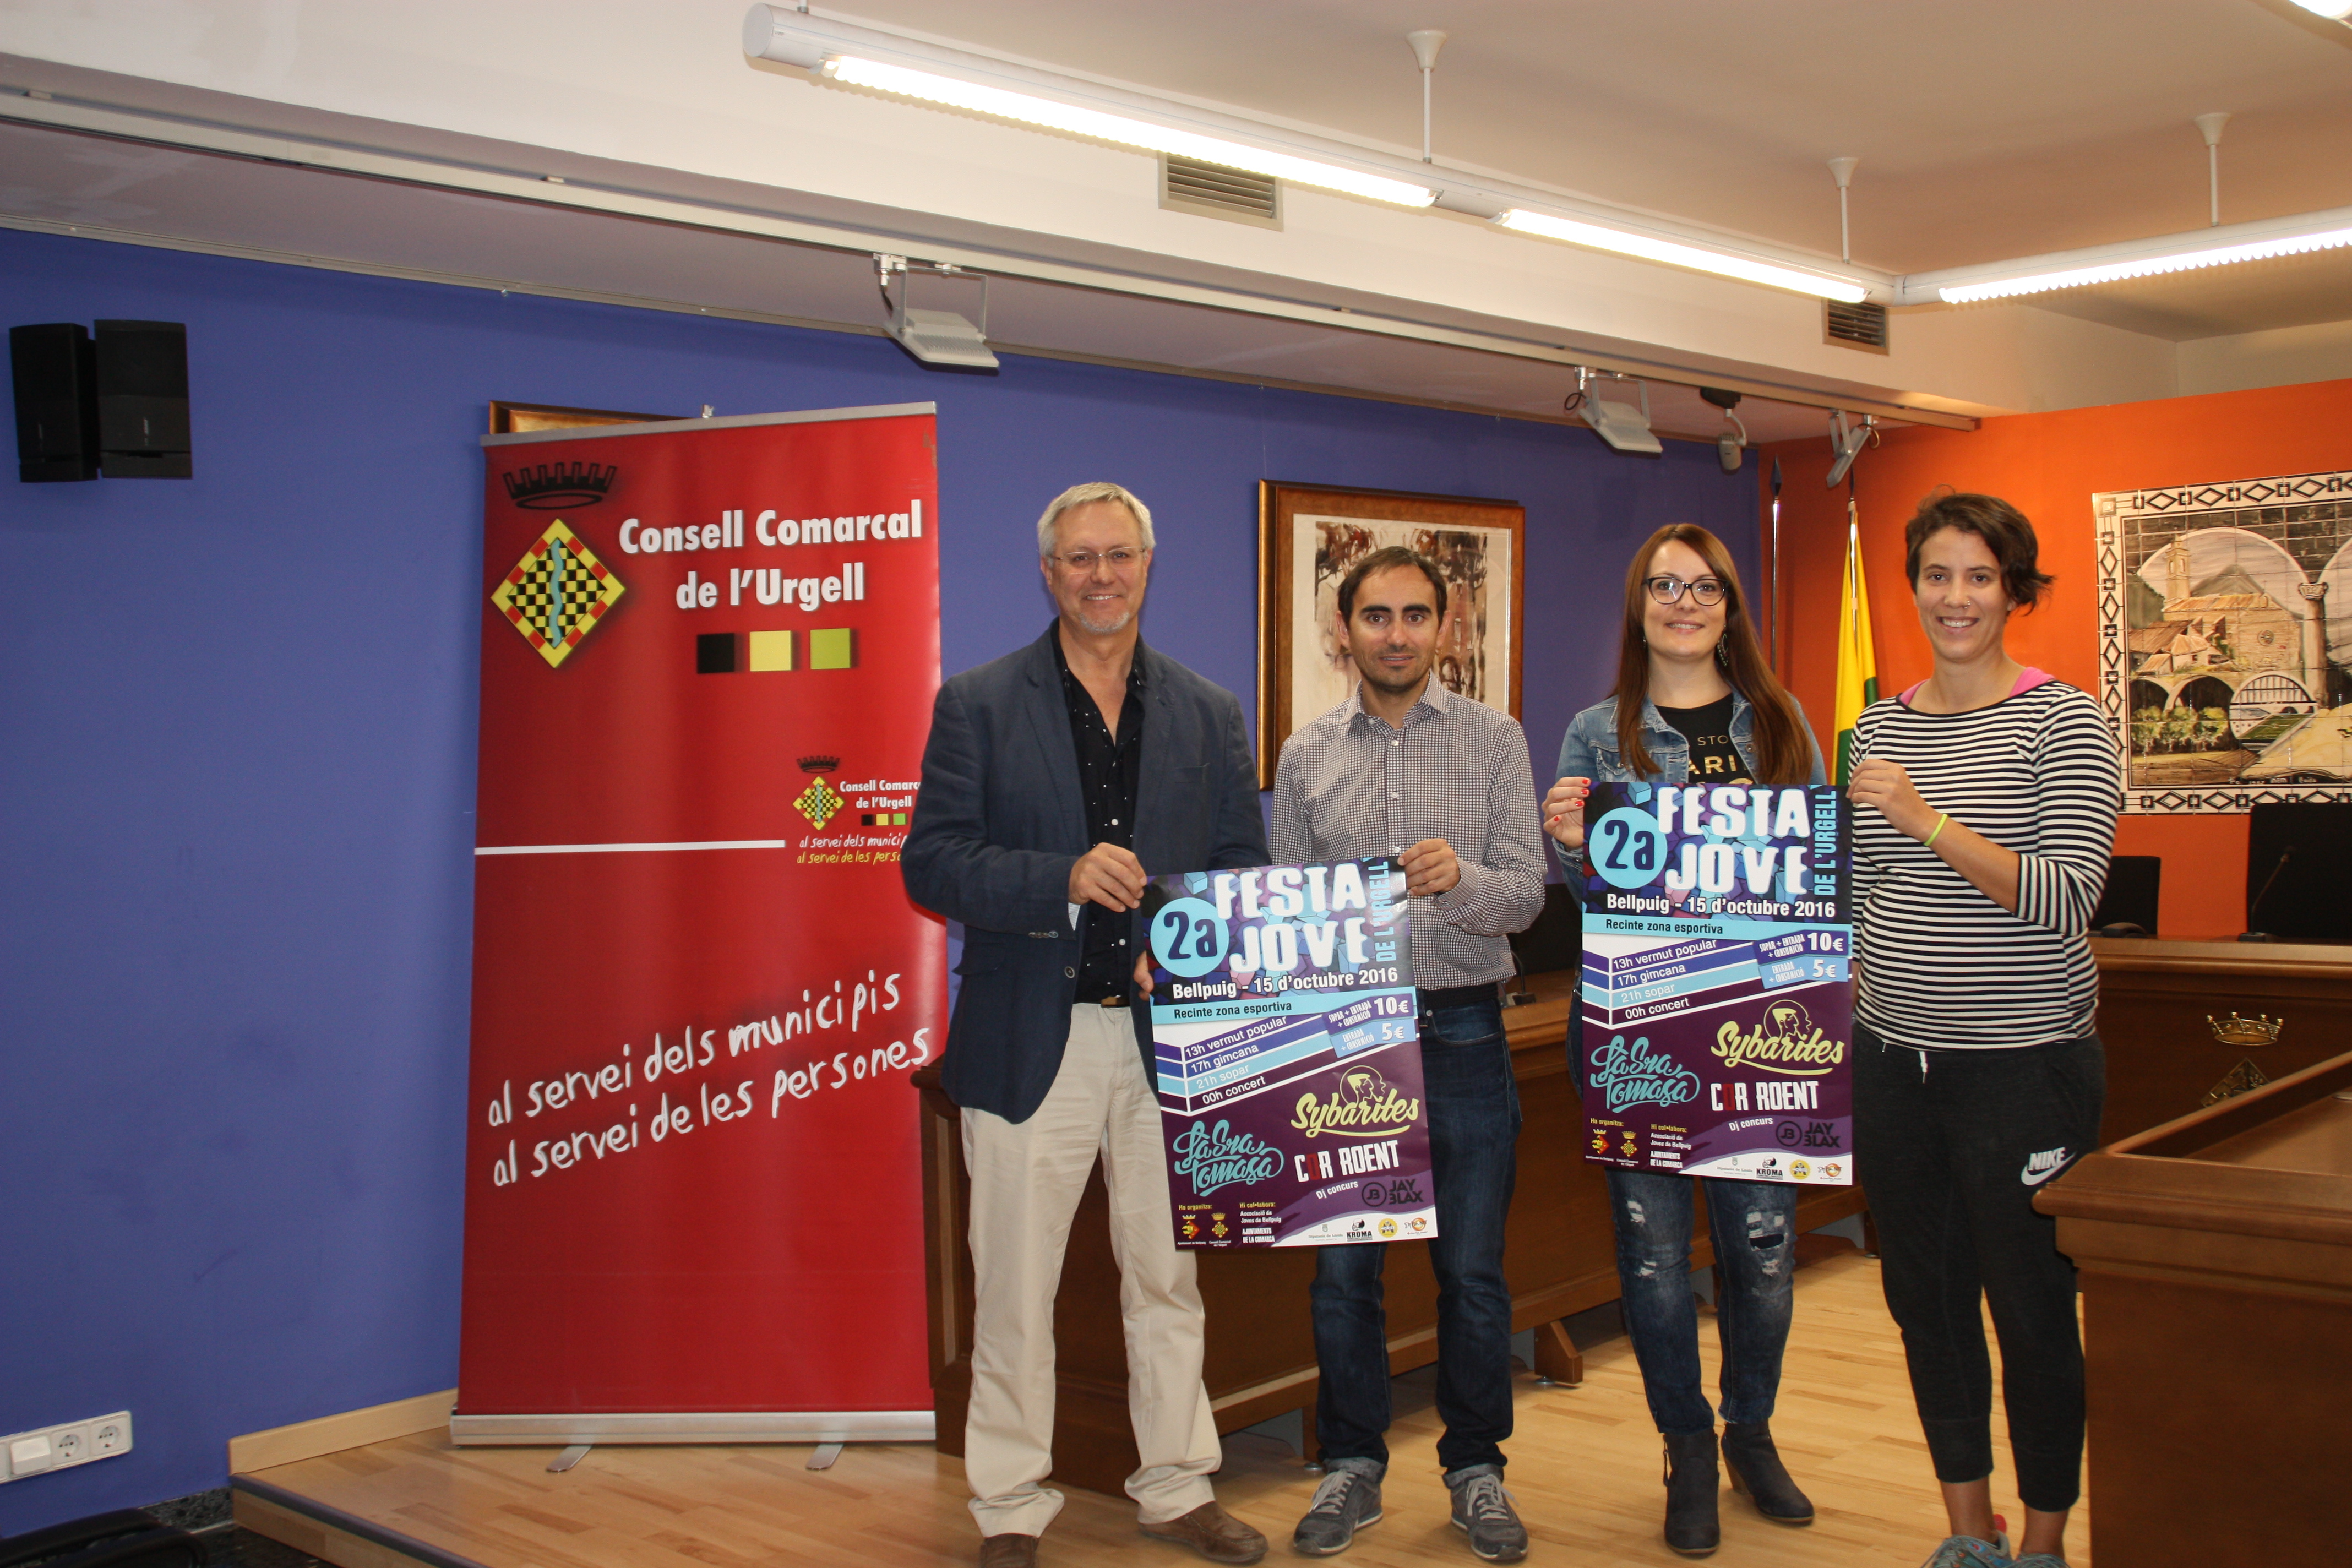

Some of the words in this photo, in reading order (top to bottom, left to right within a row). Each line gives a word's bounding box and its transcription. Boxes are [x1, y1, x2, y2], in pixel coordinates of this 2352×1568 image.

[619, 509, 744, 554] Consell
[755, 499, 922, 546] Comarcal
[676, 571, 717, 609] de
[730, 562, 864, 611] l'Urgell
[1697, 735, 1728, 745] STO
[1689, 755, 1736, 774] ARI
[840, 780, 876, 792] Consell
[879, 780, 921, 791] Comarc
[856, 797, 869, 808] de
[872, 796, 912, 809] l'Urgell
[1657, 786, 1811, 838] FESTA
[799, 835, 809, 848] al
[810, 834, 843, 848] servei
[843, 834, 865, 847] dels
[867, 833, 907, 848] munici
[1814, 791, 1837, 868] L'URGELL
[1604, 819, 1655, 870] 2a
[797, 851, 806, 863] al
[808, 851, 840, 864] servei
[841, 850, 853, 863] de
[855, 850, 870, 862] les
[873, 851, 901, 865] pers
[1664, 843, 1809, 894] JOVE
[1213, 863, 1366, 920] FESTA
[1814, 874, 1836, 895] DE
[1368, 861, 1394, 936] L'URGELL
[1607, 894, 1670, 913] Bellpuig
[1687, 897, 1706, 913] 15
[1711, 898, 1789, 916] d'octubre
[1794, 901, 1836, 917] 2016
[1163, 911, 1217, 960] 2a
[1606, 919, 1643, 930] Recinte
[1647, 923, 1670, 932] zona
[1674, 924, 1723, 934] esportiva
[1229, 917, 1369, 972] JOVE
[1375, 940, 1396, 962] DE
[1759, 941, 1776, 952] SOPAR
[1782, 934, 1805, 946] ENTRADA
[1807, 932, 1843, 951] 10€
[1614, 957, 1633, 970] 13h
[1635, 949, 1673, 964] vermut
[1675, 939, 1717, 959] popular
[1618, 974, 1637, 986] 17h
[1640, 965, 1686, 983] gimcana
[1772, 961, 1795, 974] ENTRADA
[1812, 959, 1837, 978] 5€
[1173, 982, 1237, 1000] Bellpuig
[1254, 978, 1273, 993] 15
[1278, 972, 1354, 992] d'octubre
[1359, 967, 1398, 984] 2016
[1621, 990, 1641, 1003] 21h
[1645, 984, 1674, 998] sopar
[1174, 1007, 1211, 1019] Recinte
[1216, 1007, 1240, 1016] zona
[1244, 1002, 1292, 1014] esportiva
[1329, 1011, 1344, 1023] SOPAR
[1350, 1000, 1372, 1015] ENTRADA
[1374, 997, 1409, 1015] 10€
[1625, 1007, 1646, 1019] 00h
[1648, 998, 1690, 1014] concert
[1185, 1045, 1205, 1057] 13h
[1207, 1031, 1245, 1050] vermut
[1246, 1016, 1287, 1039] popular
[1342, 1028, 1364, 1042] ENTRADA
[1382, 1023, 1404, 1041] 5€
[489, 1080, 512, 1127] al
[525, 1043, 631, 1118] servei
[644, 1025, 716, 1082] dels
[728, 968, 901, 1058] municipis
[1711, 1021, 1844, 1068] Sybarites
[1191, 1060, 1211, 1073] 17h
[1213, 1044, 1259, 1068] gimcana
[1196, 1076, 1217, 1089] 21h
[1219, 1064, 1249, 1081] sopar
[1202, 1091, 1223, 1104] 00h
[1225, 1076, 1266, 1097] concert
[1590, 1071, 1700, 1113] Tomasa
[1711, 1083, 1749, 1111] COR
[1755, 1081, 1819, 1110] ROENT
[493, 1140, 518, 1187] al
[531, 1104, 639, 1178] servei
[650, 1092, 693, 1141] de
[700, 1080, 753, 1126] les
[771, 1027, 931, 1118] persones
[1291, 1088, 1419, 1138] Sybarites
[1729, 1123, 1740, 1131] Dj
[1740, 1118, 1773, 1128] concurs
[1805, 1122, 1834, 1135] JAY
[1294, 1151, 1333, 1182] COR
[1338, 1140, 1399, 1175] ROENT
[2028, 1146, 2066, 1171] NIKE
[1174, 1147, 1284, 1197] Tomasa
[1316, 1189, 1327, 1199] Dj
[1327, 1181, 1358, 1195] concurs
[1390, 1179, 1415, 1191] JAY
